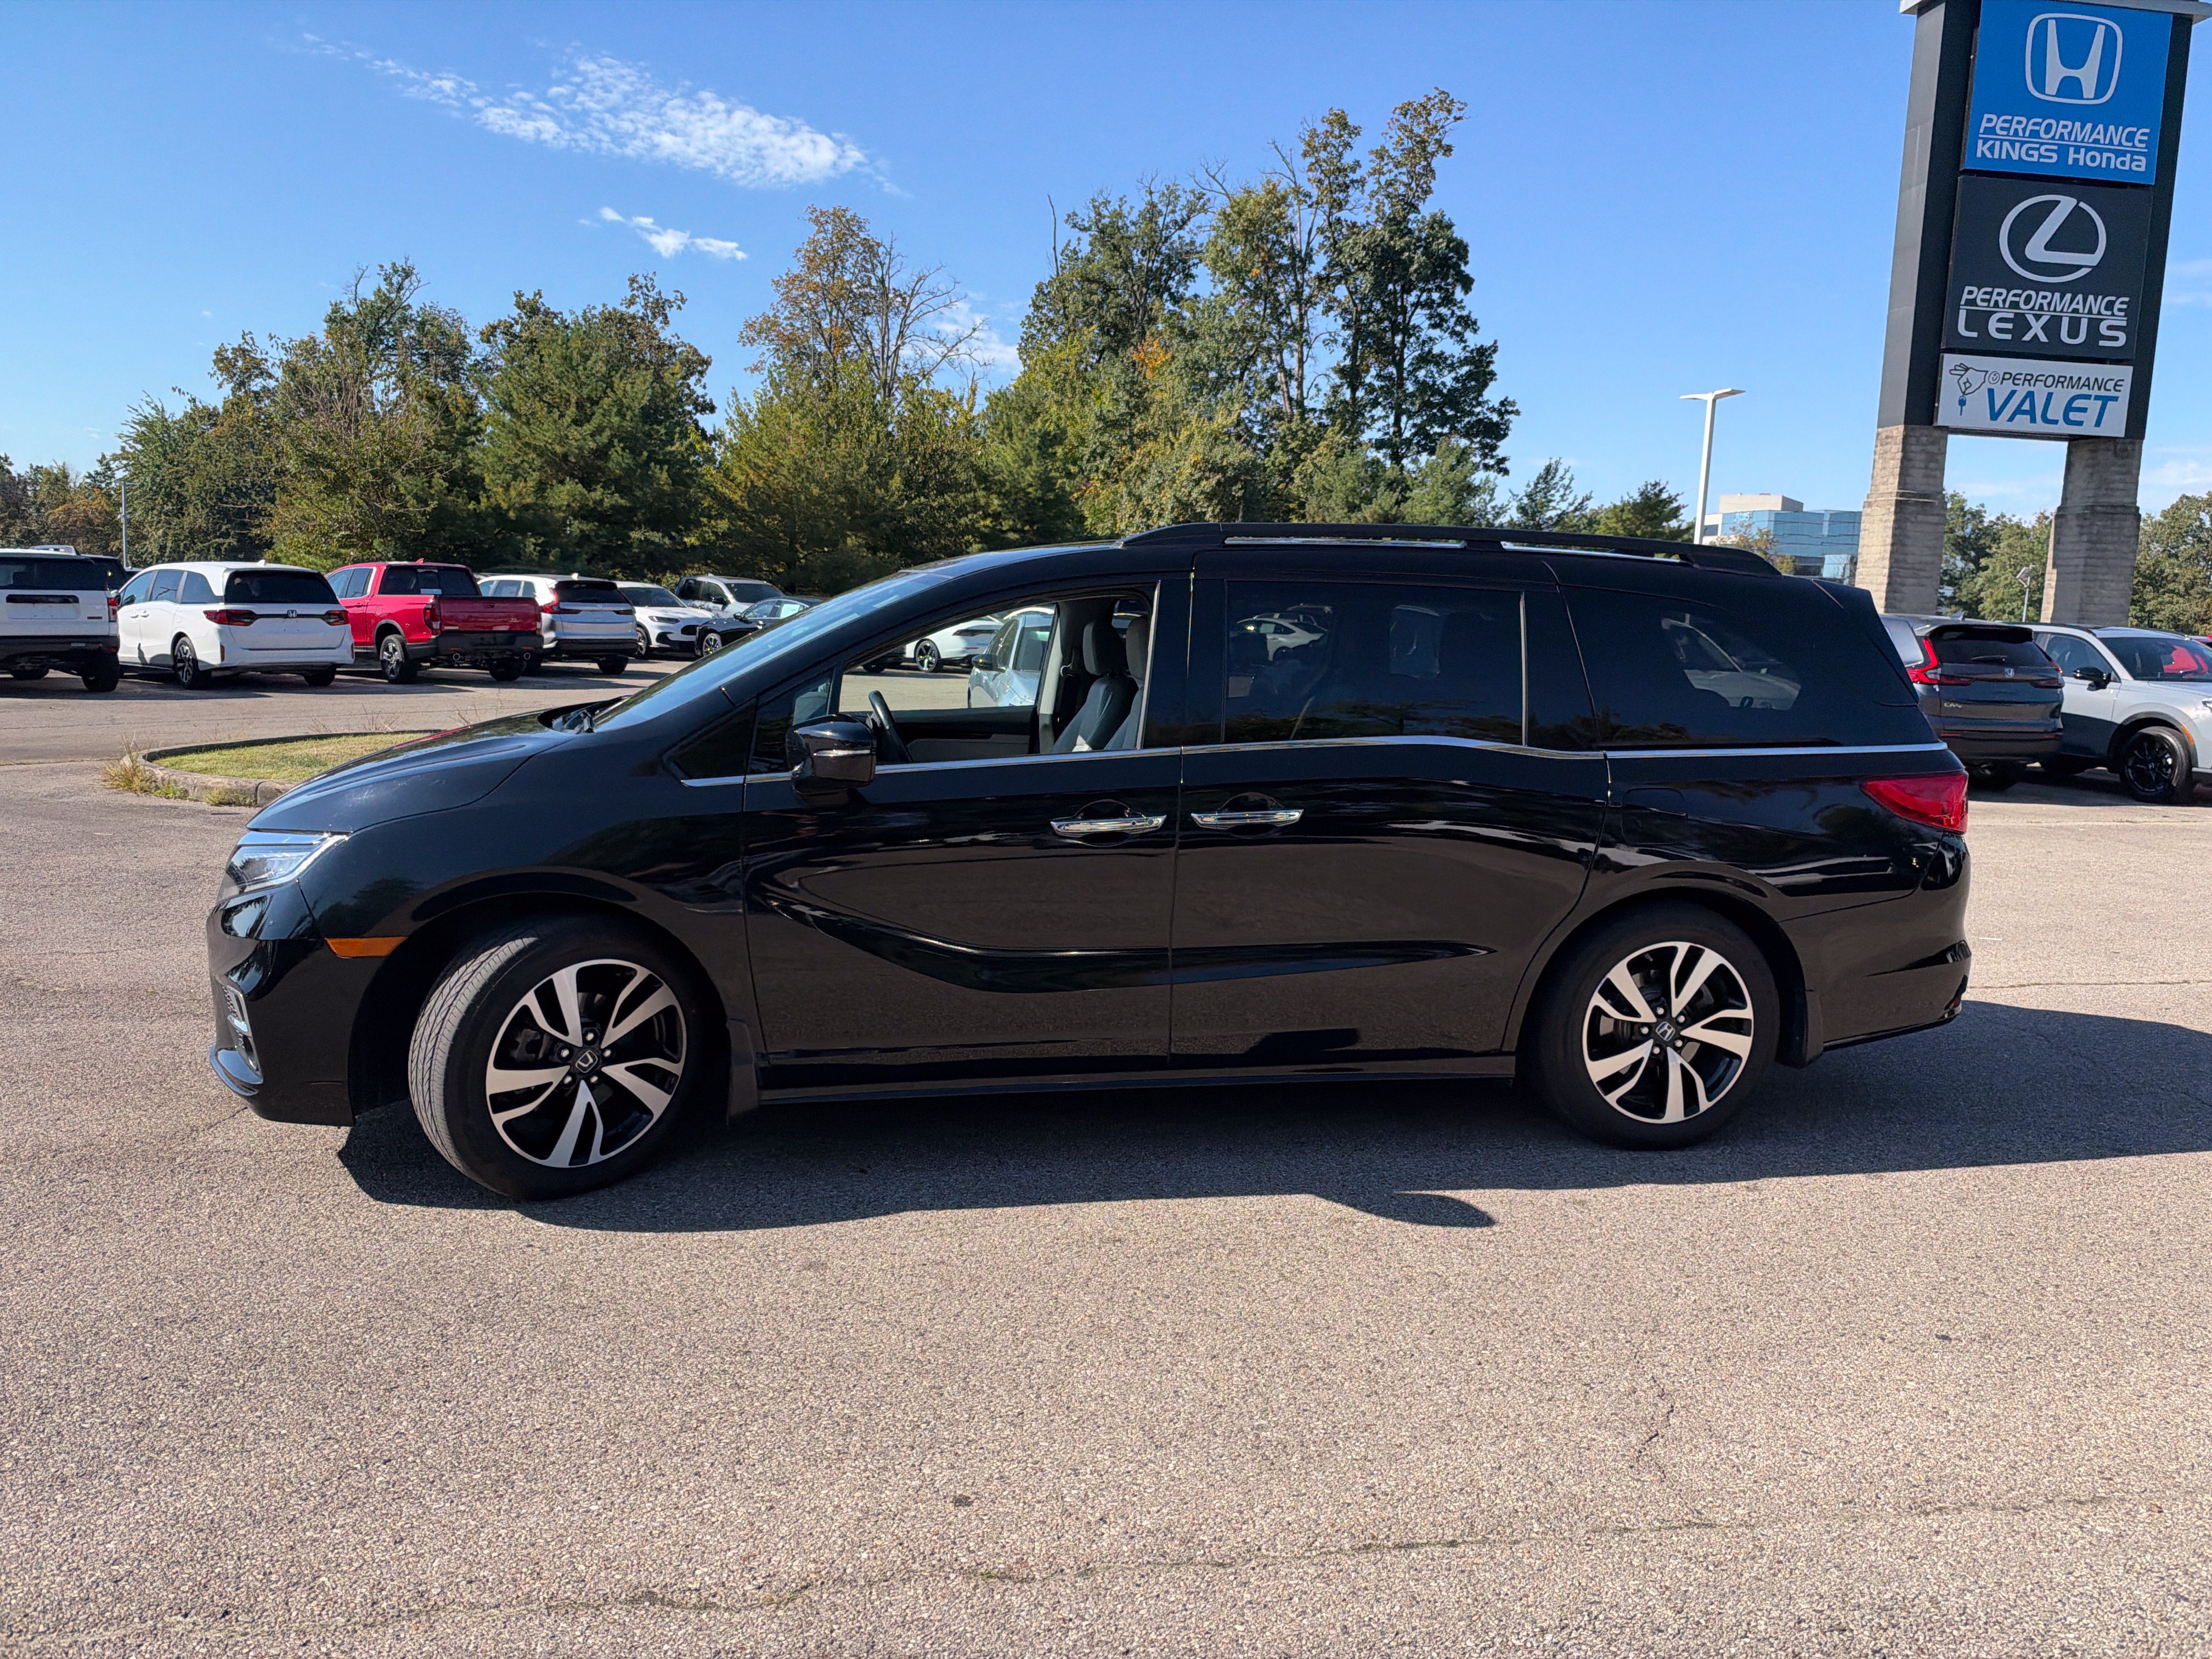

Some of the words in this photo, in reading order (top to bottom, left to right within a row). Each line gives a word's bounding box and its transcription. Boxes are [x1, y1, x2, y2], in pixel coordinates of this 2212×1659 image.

[1979, 114, 2150, 148] PERFORMANCE
[1976, 139, 2058, 163] KINGS
[2068, 147, 2146, 172] Honda
[1960, 286, 2130, 317] PERFORMANCE
[1957, 309, 2128, 347] LEXUS
[2000, 372, 2125, 392] PERFORMANCE
[1987, 388, 2119, 428] VALET
